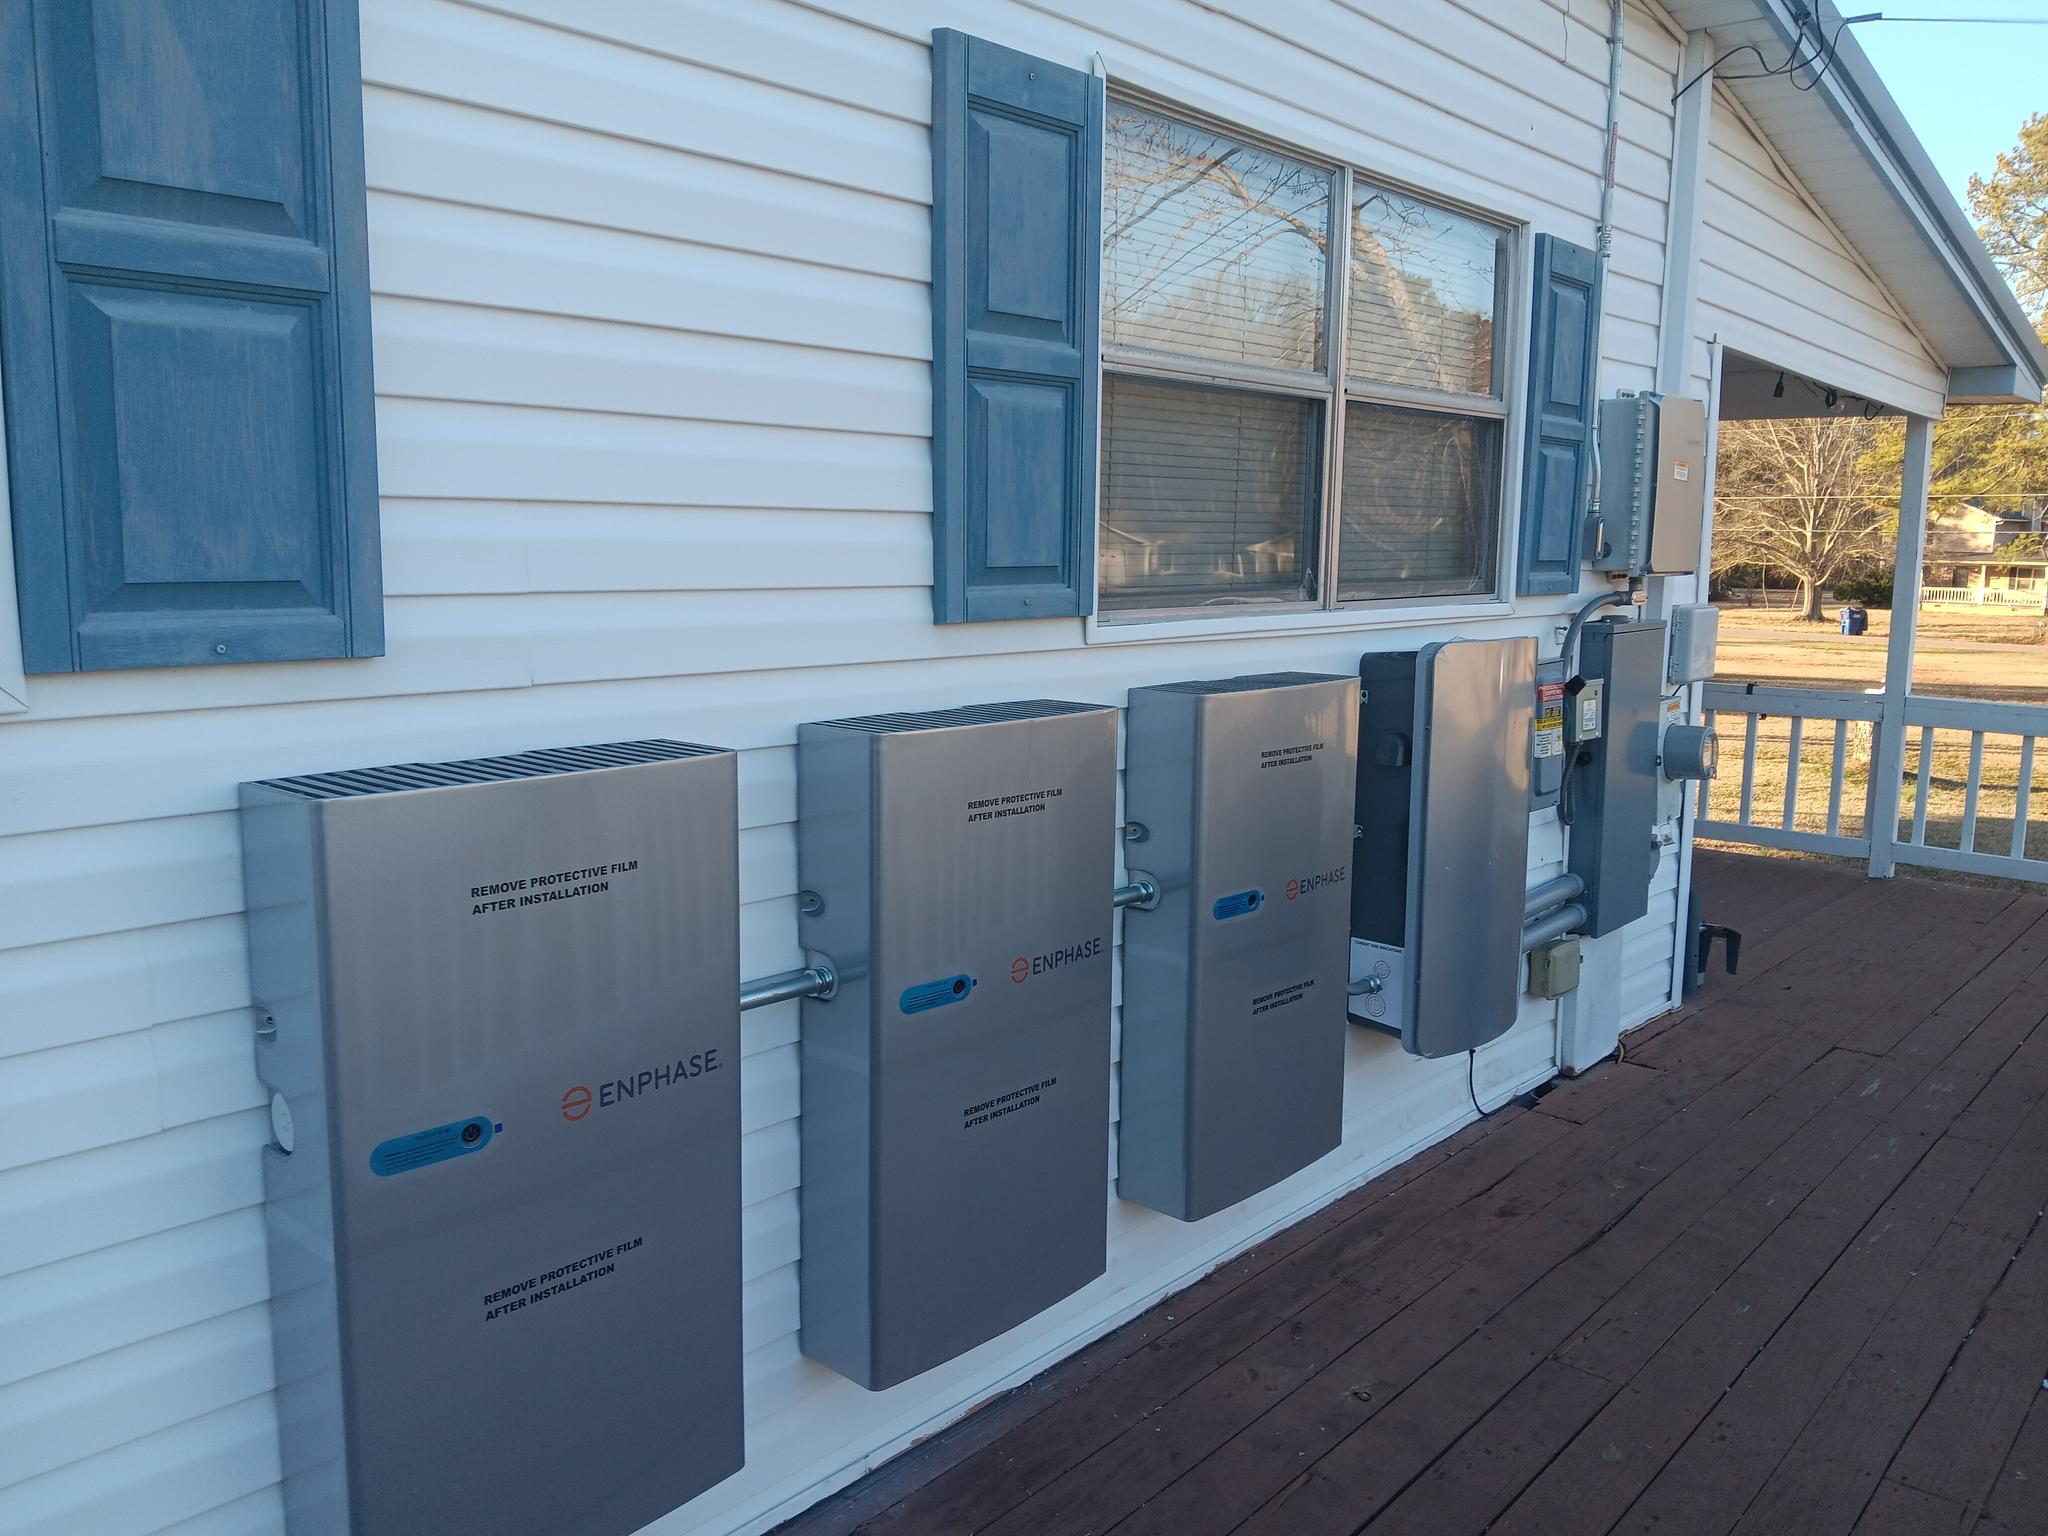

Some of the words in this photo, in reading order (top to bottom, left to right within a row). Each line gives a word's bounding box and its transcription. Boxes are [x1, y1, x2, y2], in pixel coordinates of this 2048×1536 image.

[968, 798, 999, 810] REMOVE
[1001, 791, 1045, 804] PROTECTIVE
[1046, 788, 1062, 798] FILM
[968, 811, 993, 822] AFTER
[994, 803, 1046, 818] INSTALLATION
[471, 879, 527, 898] REMOVE
[530, 865, 608, 888] PROTECTIVE
[611, 860, 638, 874] FILM
[1300, 866, 1345, 894] ENPHASE
[472, 898, 516, 915] AFTER
[519, 882, 609, 907] INSTALLATION
[1032, 937, 1101, 975] ENPHASE
[600, 1049, 718, 1108] ENPHASE
[964, 1099, 995, 1117] REMOVE
[996, 1083, 1040, 1105] PROTECTIVE
[1041, 1077, 1057, 1089] FILM
[964, 1114, 989, 1130] AFTER
[990, 1095, 1040, 1119] INSTALLATION
[483, 1278, 537, 1305] REMOVE
[540, 1248, 614, 1285] PROTECTIVE
[616, 1237, 643, 1255] FILM
[485, 1298, 527, 1321] AFTER
[530, 1263, 615, 1304] INSTALLATION
